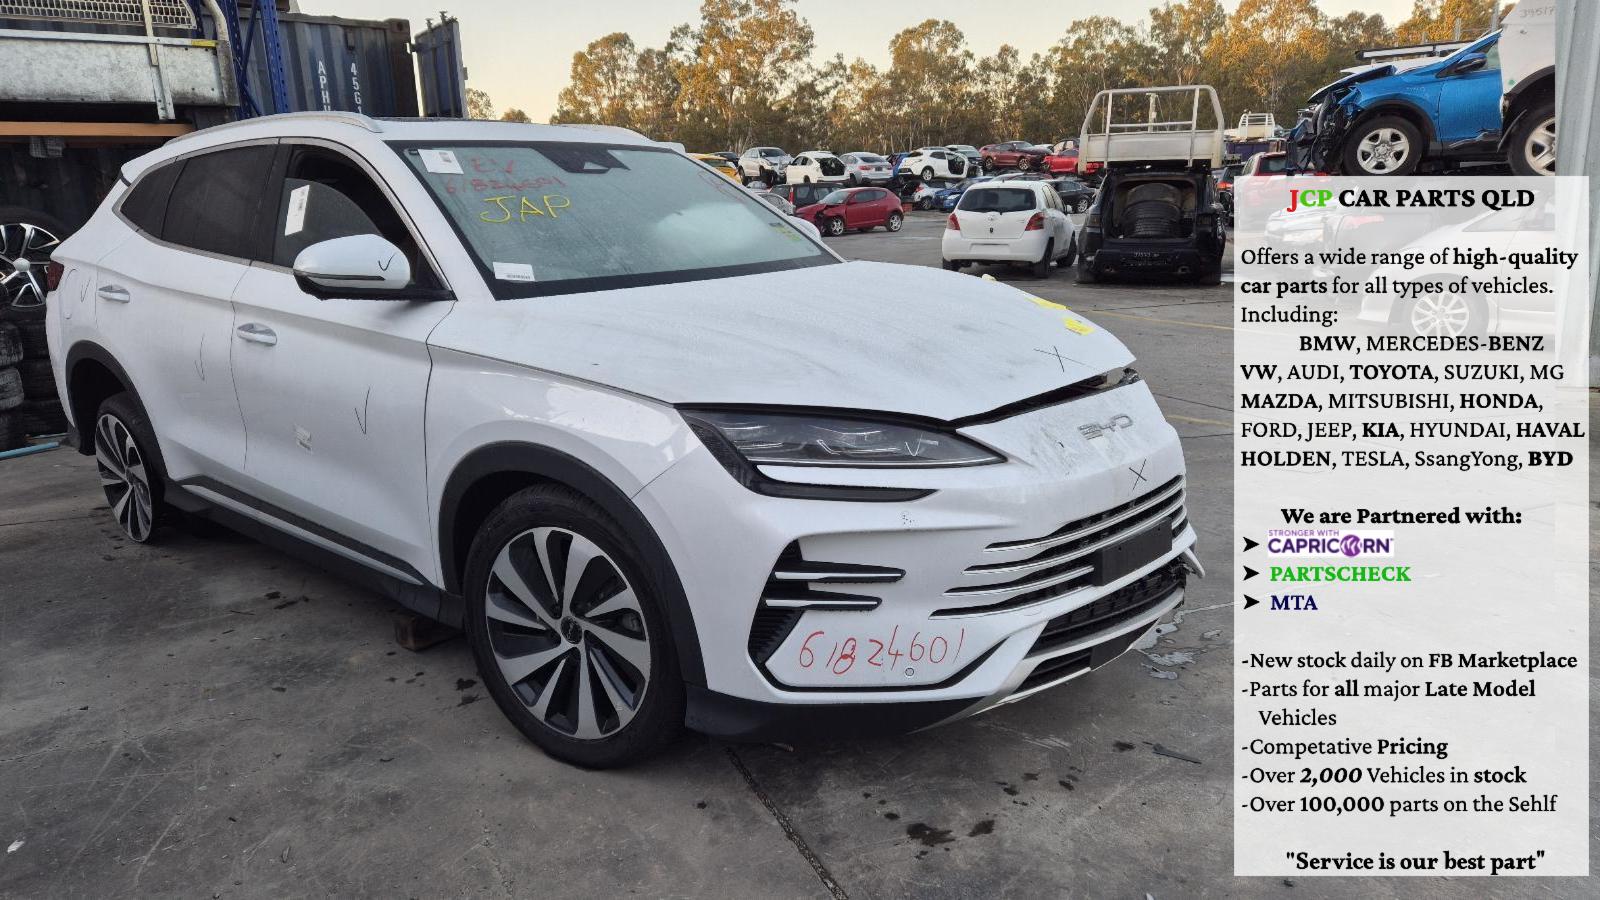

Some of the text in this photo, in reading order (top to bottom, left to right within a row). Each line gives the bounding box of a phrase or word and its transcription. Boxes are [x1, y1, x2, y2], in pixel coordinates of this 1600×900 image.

[479, 194, 571, 223] JAP
[1077, 412, 1134, 441] BYD
[799, 624, 965, 675] 61824601
